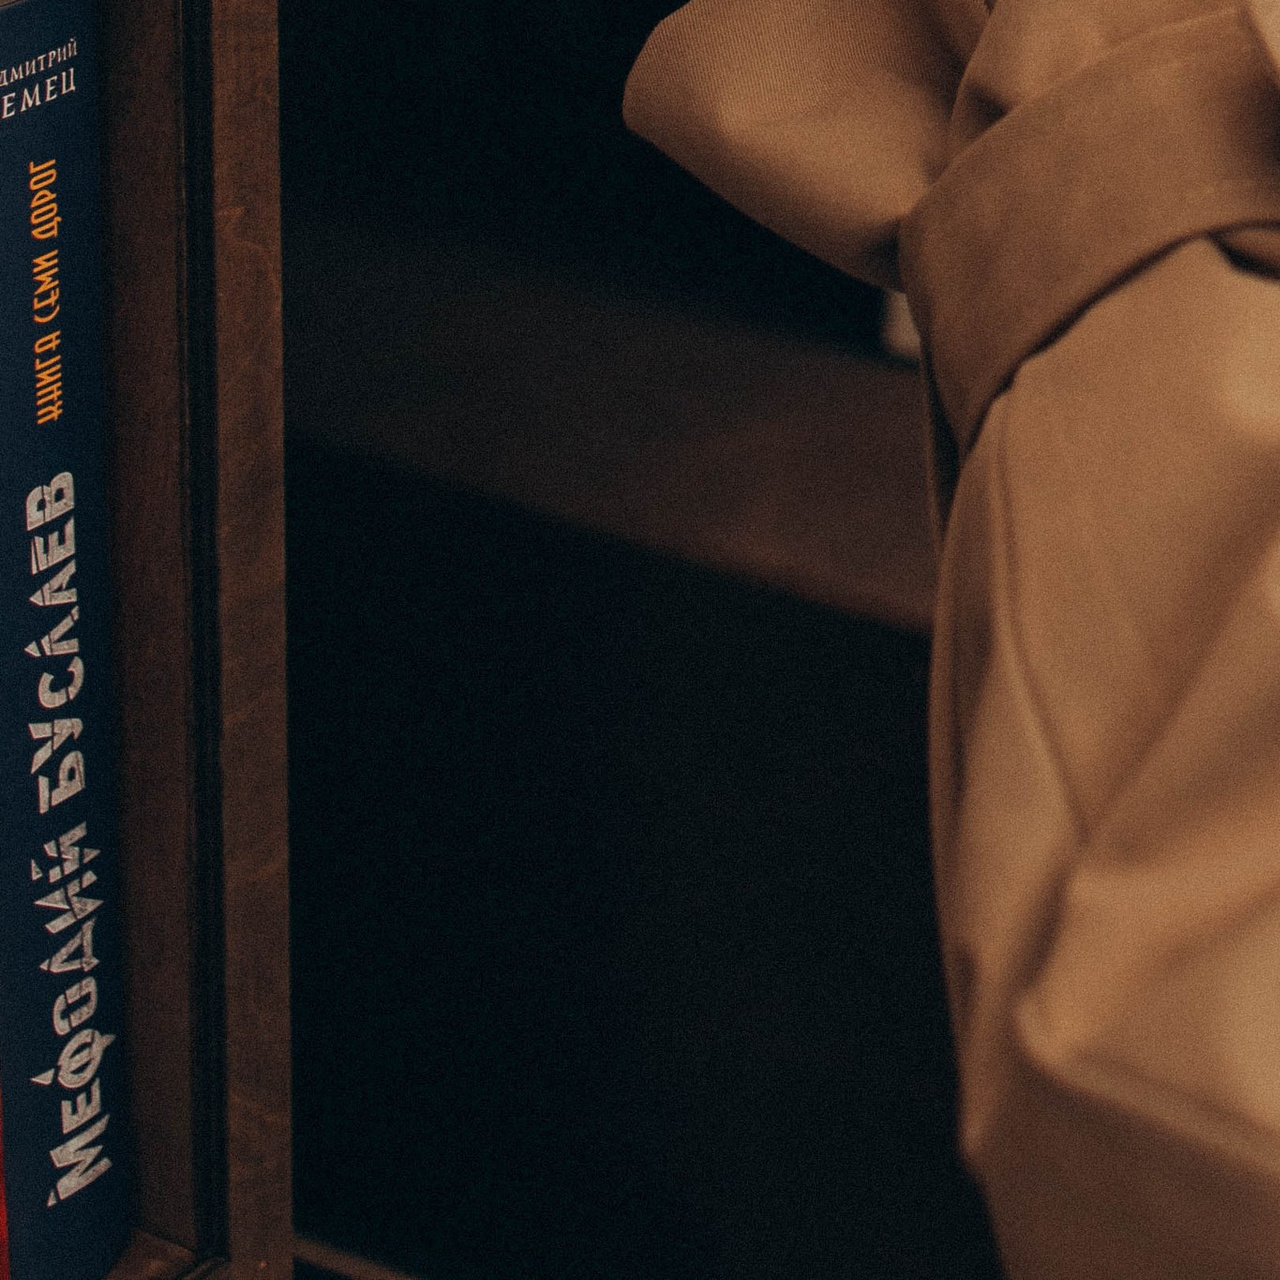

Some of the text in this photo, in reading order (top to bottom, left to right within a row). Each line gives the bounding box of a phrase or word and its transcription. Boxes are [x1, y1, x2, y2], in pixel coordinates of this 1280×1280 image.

[2, 67, 76, 119] ЕМЕЦ
[29, 158, 64, 425] КНИГА СЕМИ ДОРОГ
[25, 471, 116, 1208] МЕФОДИЙ БУСЛАЕВ
